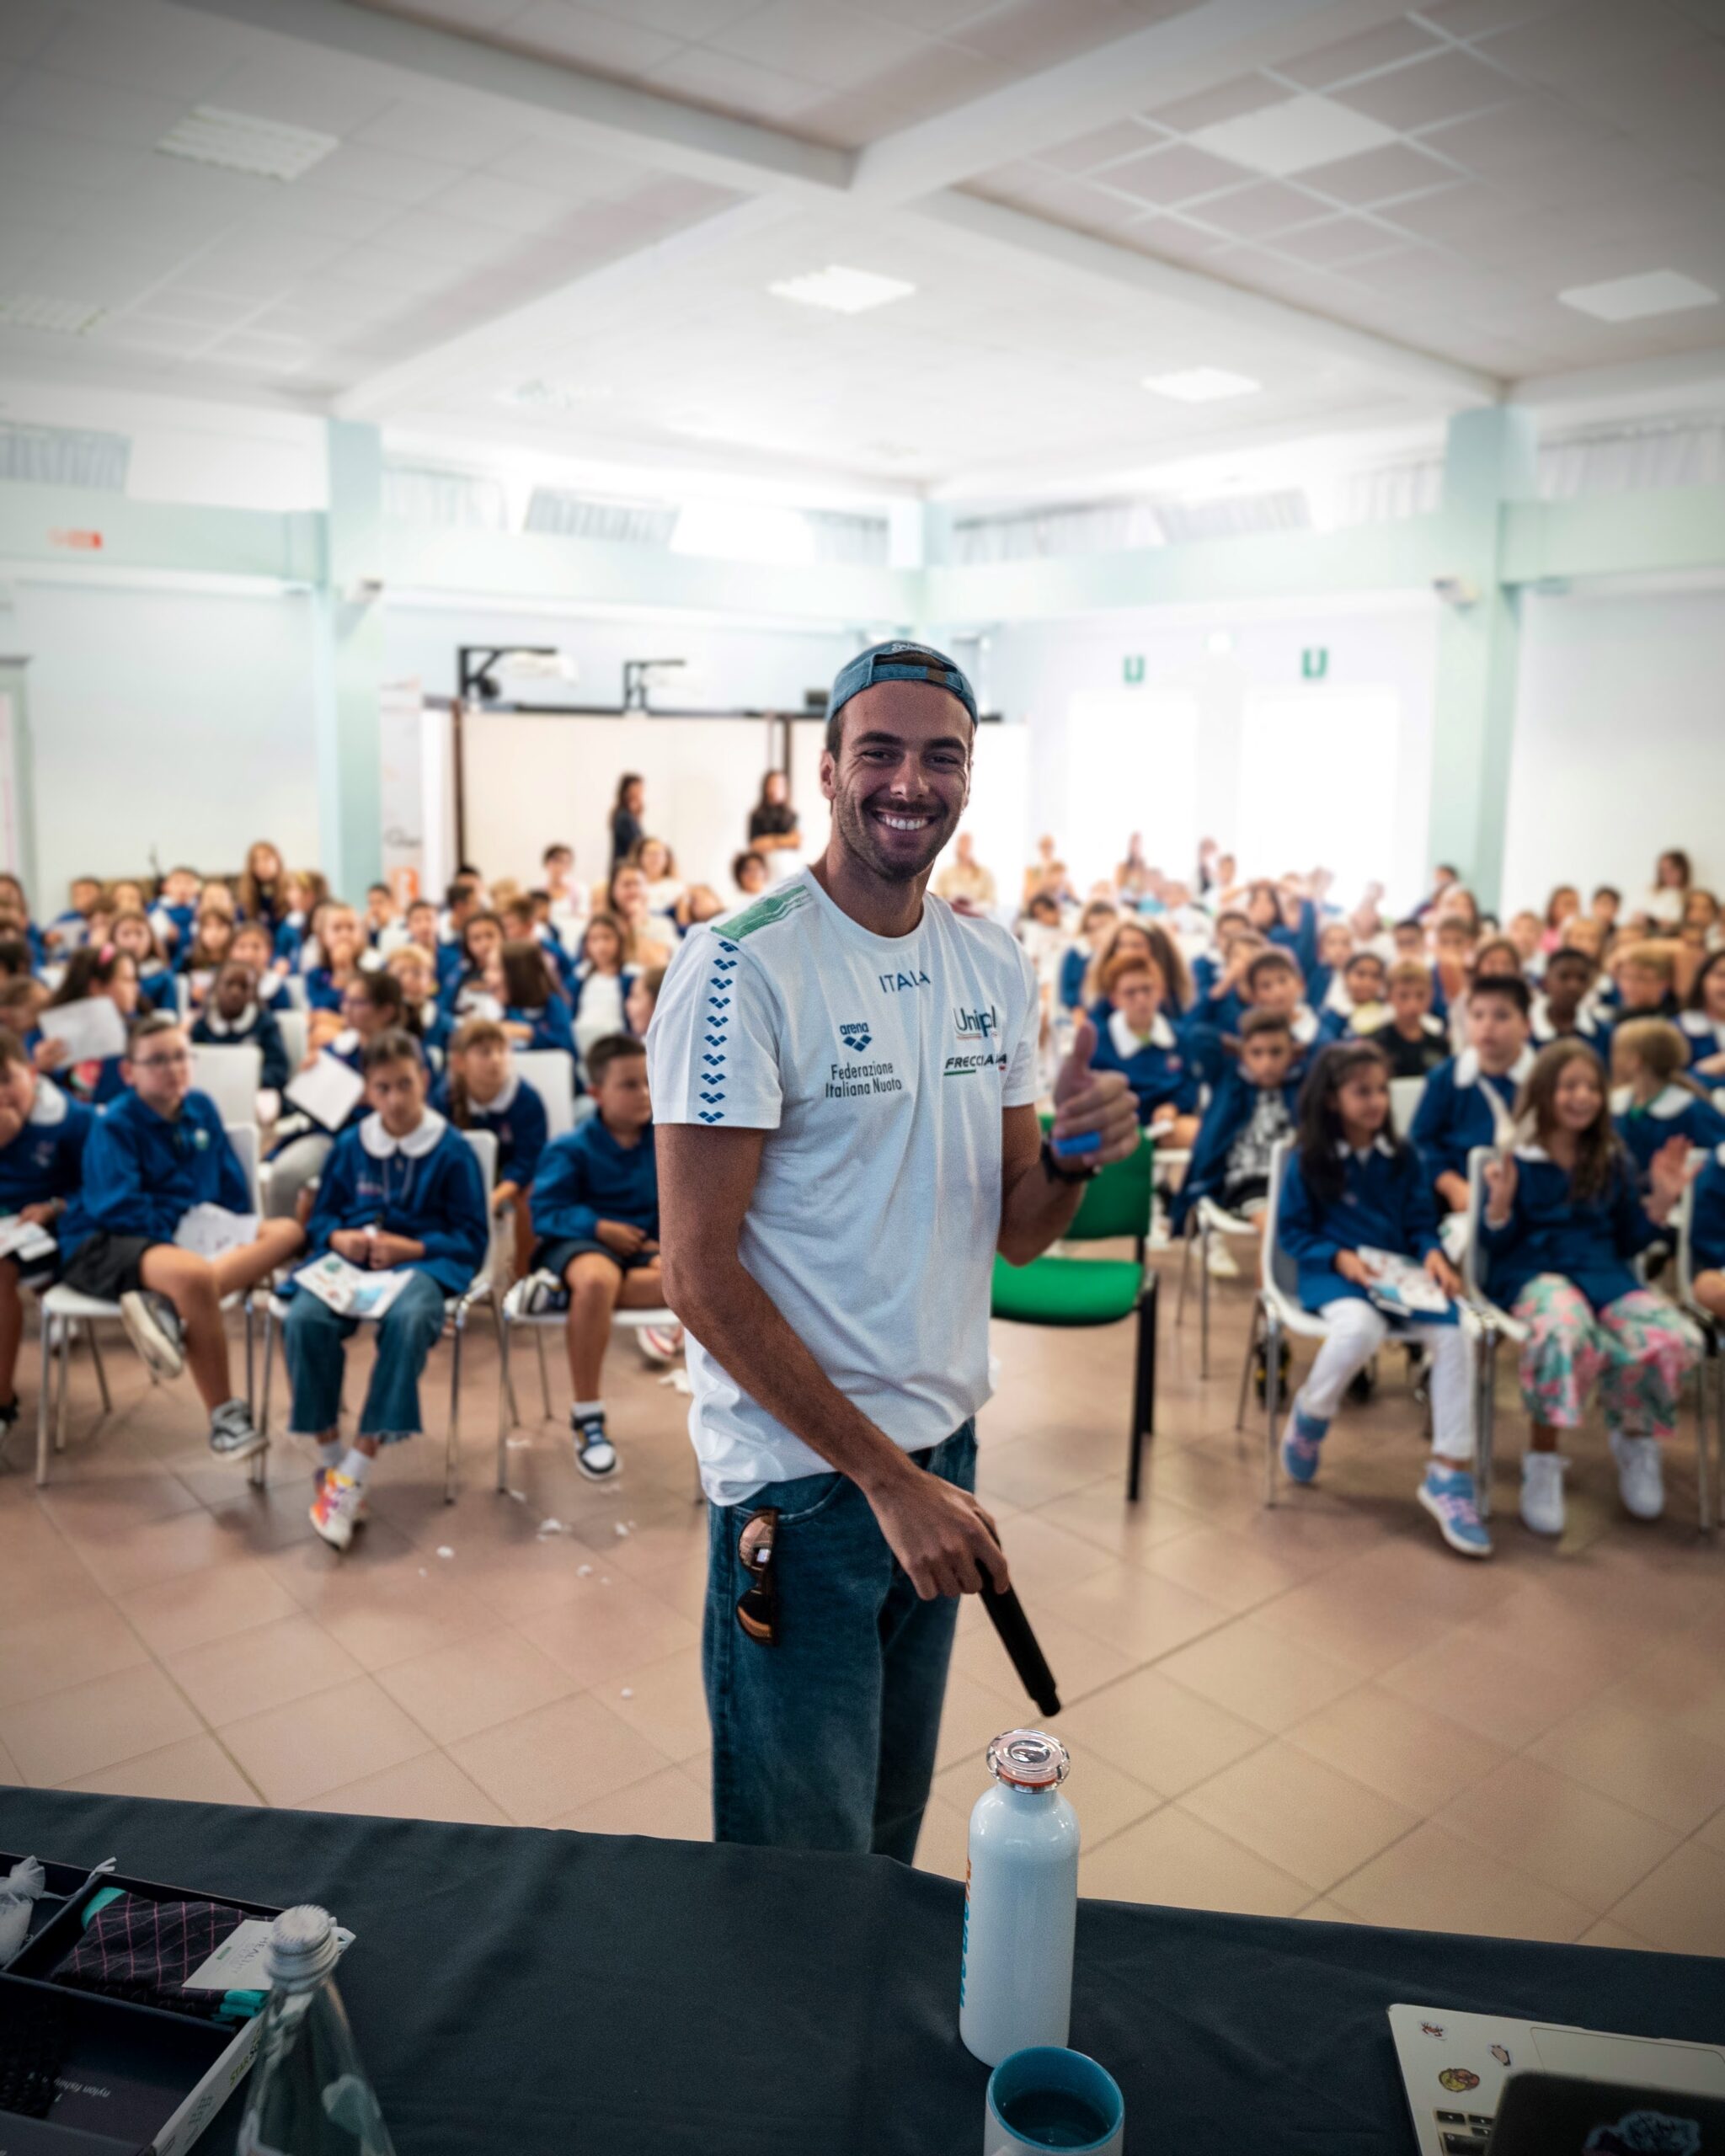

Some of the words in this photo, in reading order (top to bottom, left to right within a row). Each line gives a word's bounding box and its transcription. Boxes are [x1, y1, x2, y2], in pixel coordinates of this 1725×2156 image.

[839, 1022, 870, 1035] arena
[830, 1060, 894, 1081] Federazione
[825, 1081, 871, 1098] Italiana
[872, 1078, 902, 1093] Nuoto
